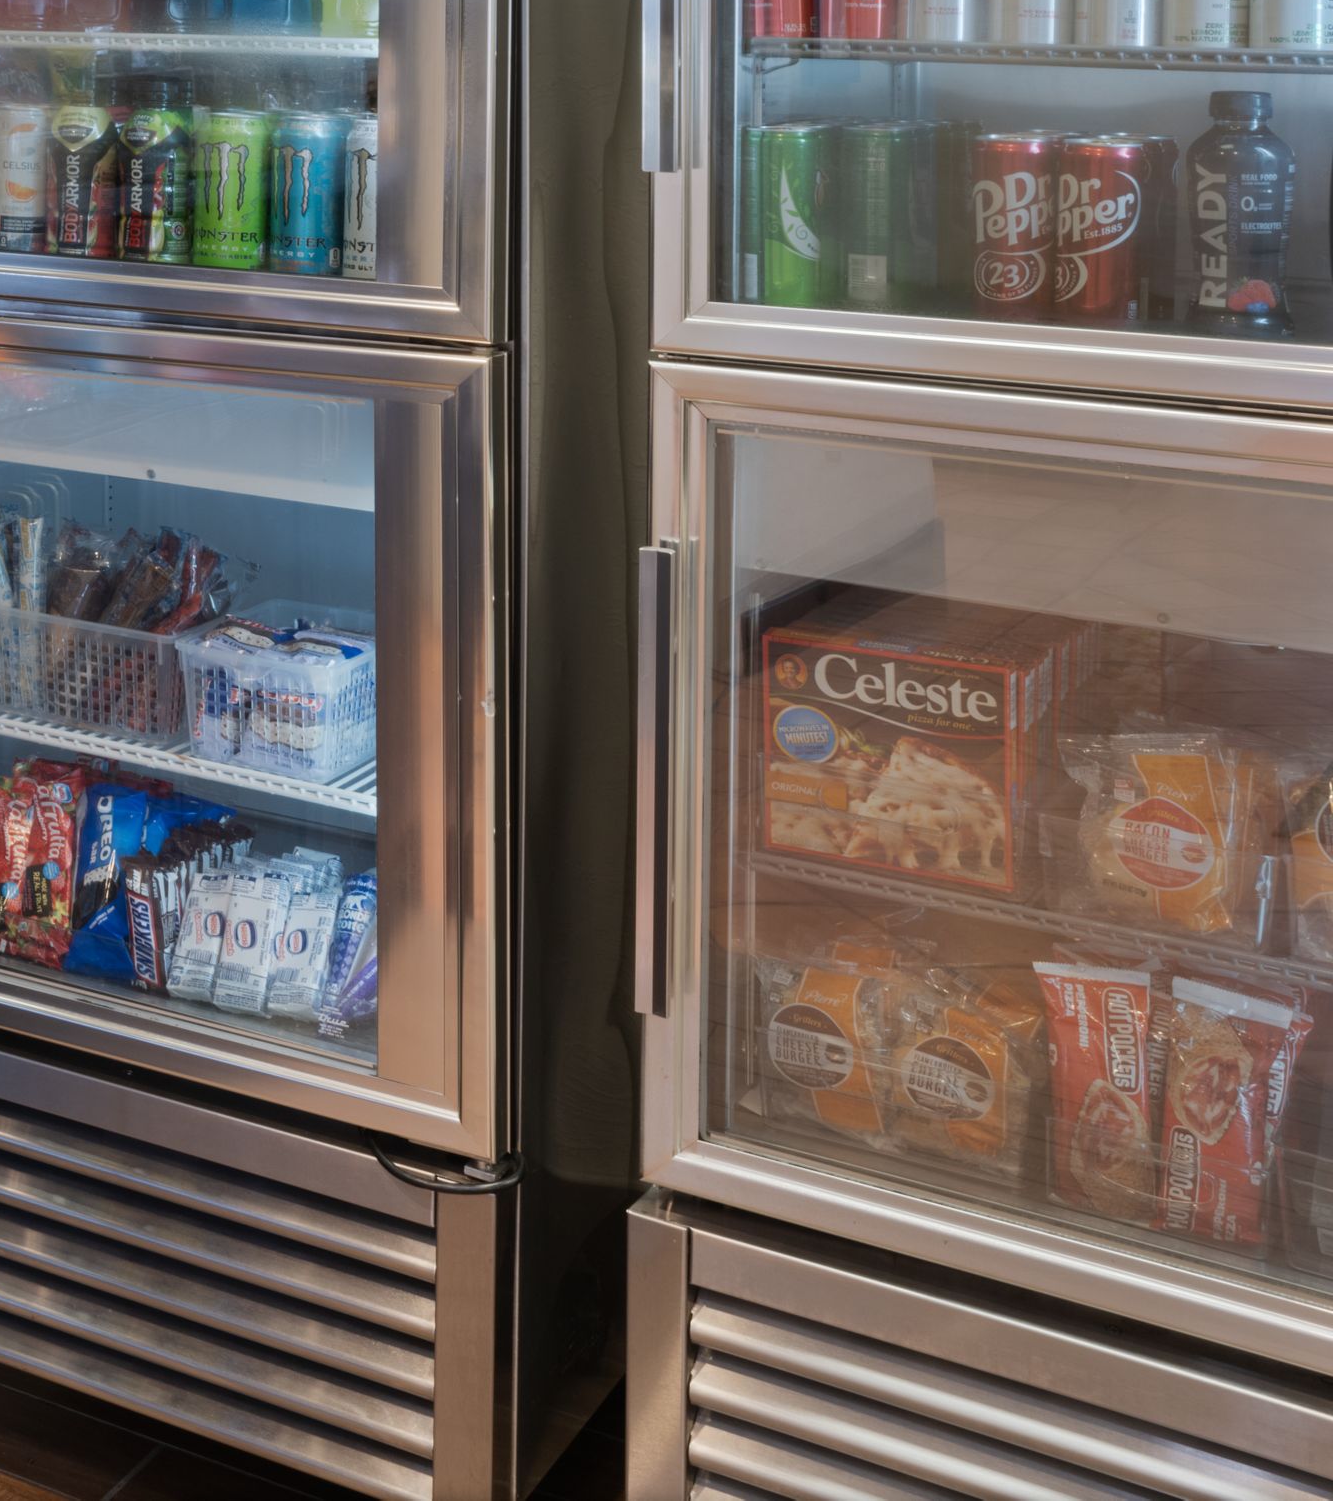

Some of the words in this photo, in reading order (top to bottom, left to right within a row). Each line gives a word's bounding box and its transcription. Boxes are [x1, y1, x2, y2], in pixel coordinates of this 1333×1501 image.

[1004, 172, 1051, 203] Dr
[1241, 173, 1258, 182] REAL
[1261, 173, 1277, 182] FOOD
[64, 154, 81, 244] BODYARMOR
[1197, 164, 1228, 308] READY
[988, 263, 1019, 287] 23
[814, 653, 998, 723] Celeste
[907, 713, 933, 724] pizza
[935, 716, 950, 727] for
[952, 721, 976, 732] one.
[785, 731, 829, 745] MINUTES!
[97, 796, 114, 860] OREO
[1125, 822, 1171, 840] BACON
[1125, 847, 1170, 864] BURGER
[132, 897, 158, 982] SNICKERS
[775, 1034, 820, 1054] CHEESE
[775, 1048, 821, 1066] BURGER
